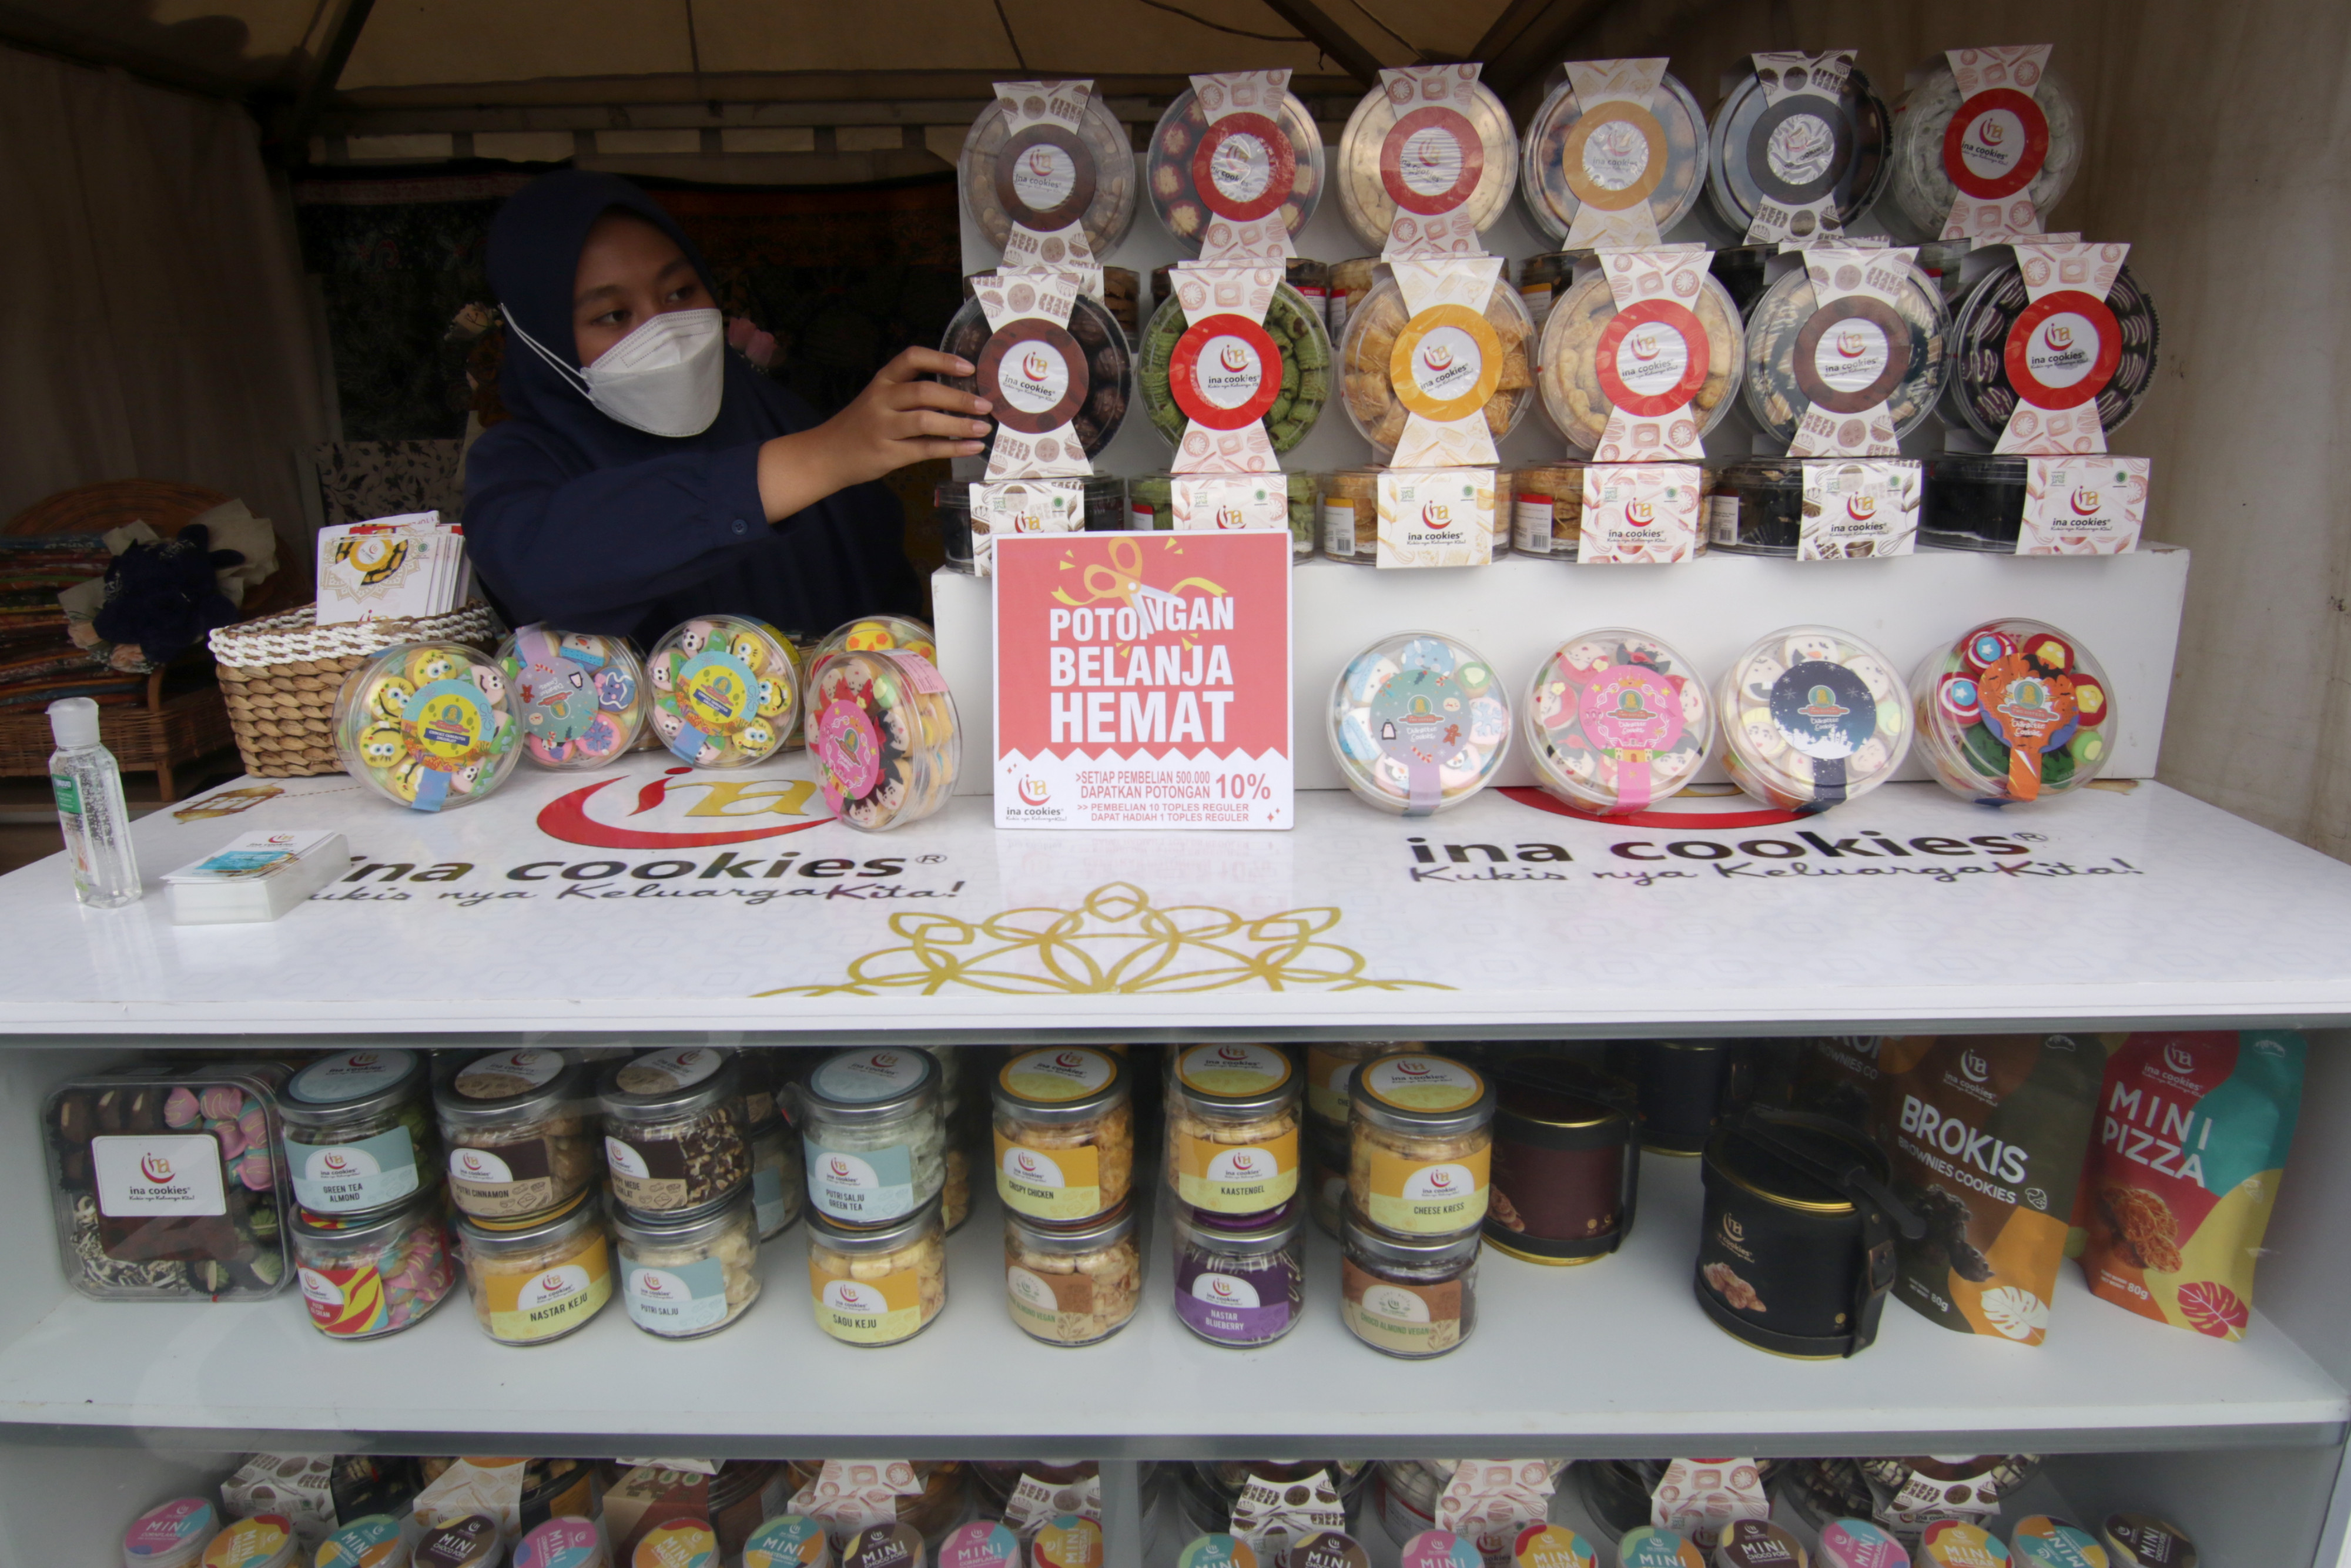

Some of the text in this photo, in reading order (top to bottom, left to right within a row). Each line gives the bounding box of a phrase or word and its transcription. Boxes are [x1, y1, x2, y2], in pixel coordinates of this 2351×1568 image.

[1050, 597, 1234, 641] POTONGAN
[1050, 645, 1234, 687] BELANJA
[1050, 691, 1234, 743] HEMAT
[1118, 771, 1173, 785] PEMBELIAN
[1176, 771, 1211, 785] 500.000
[1081, 785, 1211, 799] DAPATKAN POTONGAN
[1215, 773, 1271, 800] 10%
[1007, 807, 1022, 816] ina
[1091, 803, 1250, 812] PEMBELIAN 10 TOPLES REGULER
[1091, 813, 1123, 822] DAPAT
[1124, 813, 1158, 822] HADIAH
[1166, 813, 1203, 822] TOPLES
[1204, 813, 1250, 822] REGULER
[1406, 837, 1573, 865] ina
[343, 856, 472, 882] ina
[309, 883, 411, 902] ukis
[2109, 1081, 2213, 1151] MINI
[1898, 1094, 2030, 1184] BROKIS
[2102, 1115, 2205, 1189] PIZZA
[1898, 1135, 2017, 1205] BROWNIES COOKIES
[130, 1186, 146, 1195] ina
[323, 1182, 363, 1194] GREEN TEA
[473, 1185, 509, 1198] CINNAMON
[825, 1188, 865, 1202] PUTRI SALJU
[1009, 1180, 1054, 1200] CRISPY CHICKEN
[1221, 1185, 1265, 1196] KAASTENGEL
[329, 1192, 360, 1203] ALMOND
[829, 1199, 863, 1211] GREEN TEA
[1414, 1202, 1465, 1215] CHEESE KRESS
[2127, 1282, 2148, 1300] 80g
[530, 1292, 588, 1322] NASTAR KEJU
[640, 1303, 679, 1316] PUTRI SALJU
[1211, 1309, 1238, 1321] NASTAR
[855, 1317, 877, 1329] KEJU
[1205, 1318, 1245, 1332] BLUEBERRY
[1379, 1319, 1407, 1335] ALMOND
[1408, 1325, 1430, 1336] VEGAN
[146, 1520, 191, 1531] MINI
[439, 1533, 477, 1554] MINI
[763, 1536, 806, 1557] MINI
[1740, 1539, 1786, 1554] MINI
[862, 1540, 906, 1564] MINI
[957, 1542, 1002, 1561] MINI
[1532, 1550, 1578, 1563] MINI
[1943, 1544, 1994, 1560] MINI
